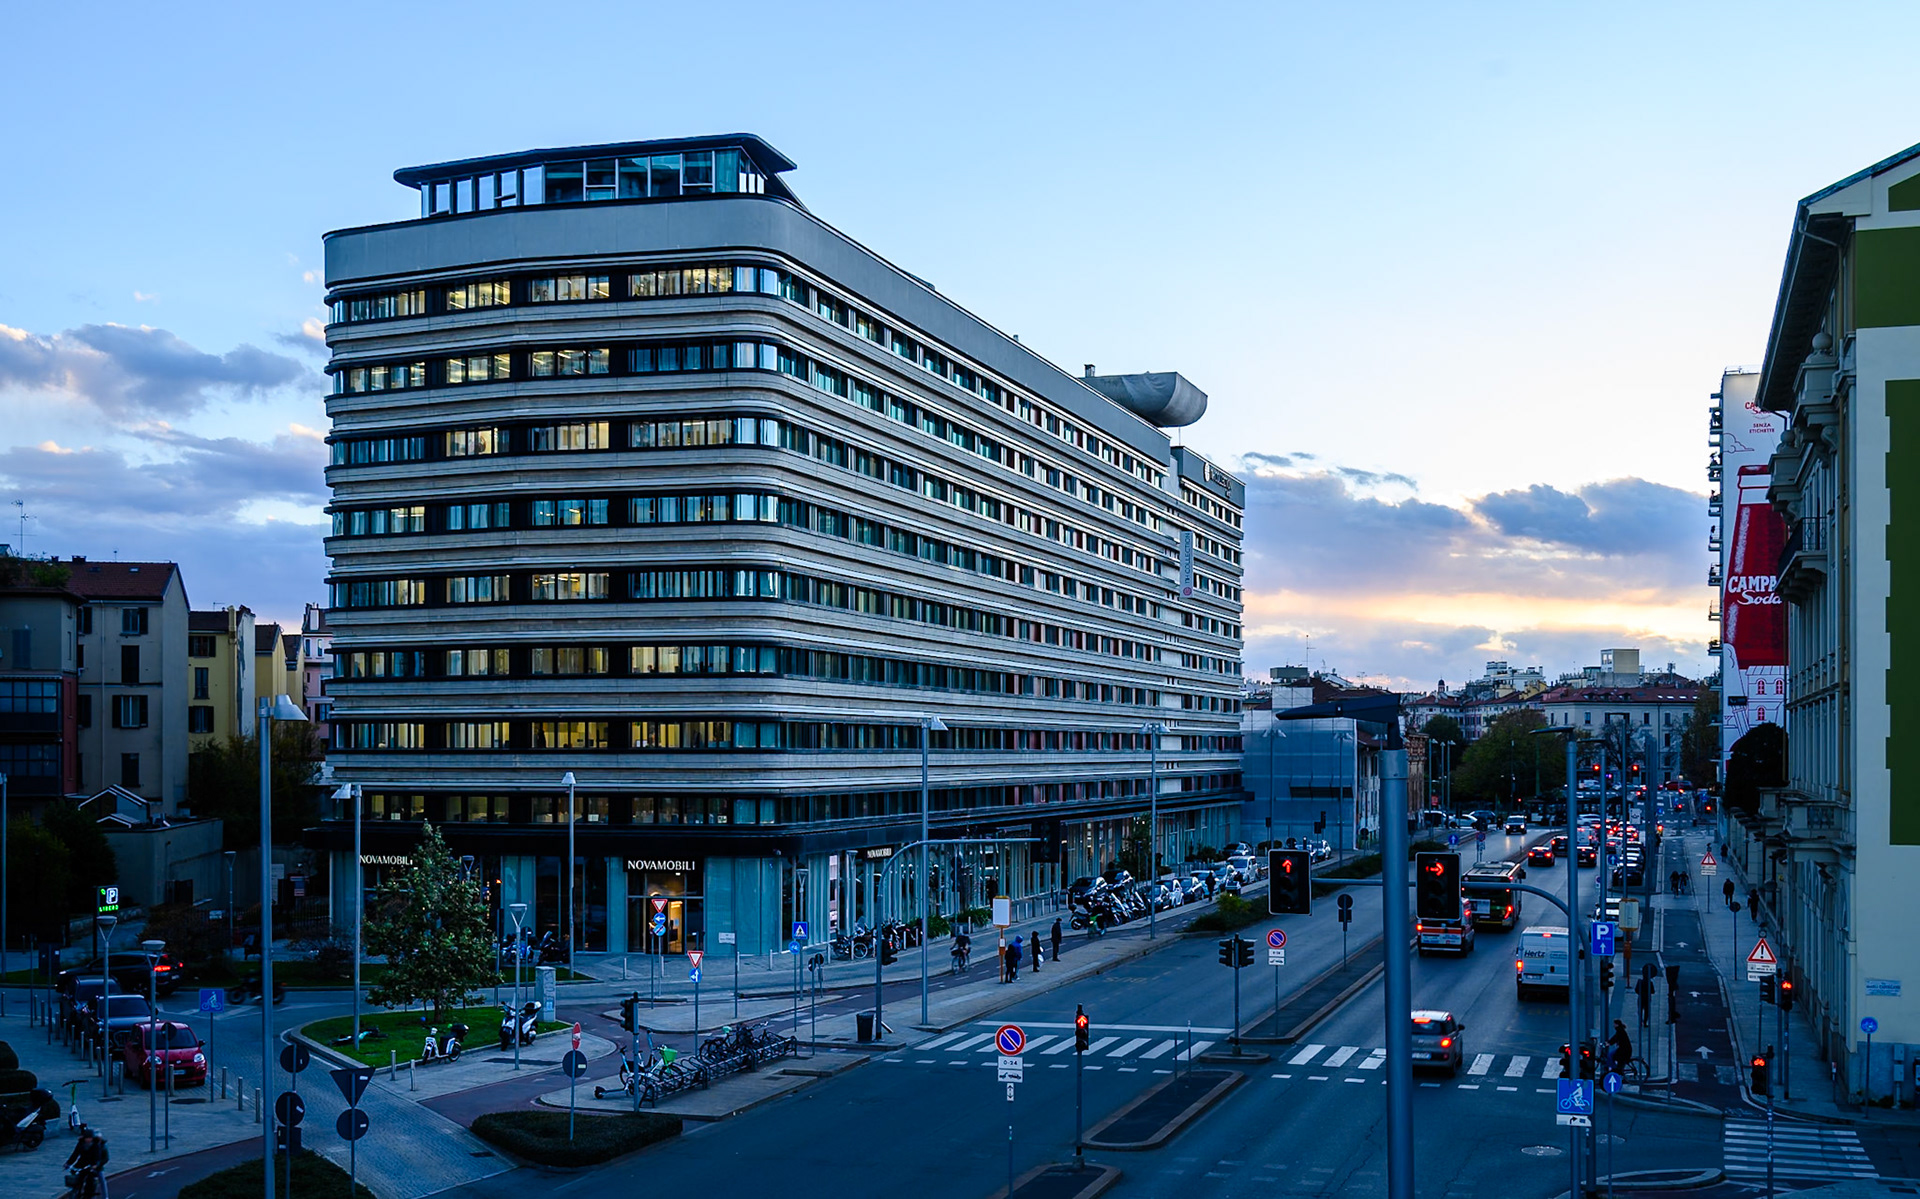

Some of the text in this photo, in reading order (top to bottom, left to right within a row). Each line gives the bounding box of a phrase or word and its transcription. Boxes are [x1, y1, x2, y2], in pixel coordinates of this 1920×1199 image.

[1728, 575, 1777, 593] CAMPA
[1737, 589, 1782, 605] Soda
[628, 860, 695, 871] NOVAMOBILI
[1597, 925, 1609, 940] P
[1524, 950, 1546, 958] Hertz
